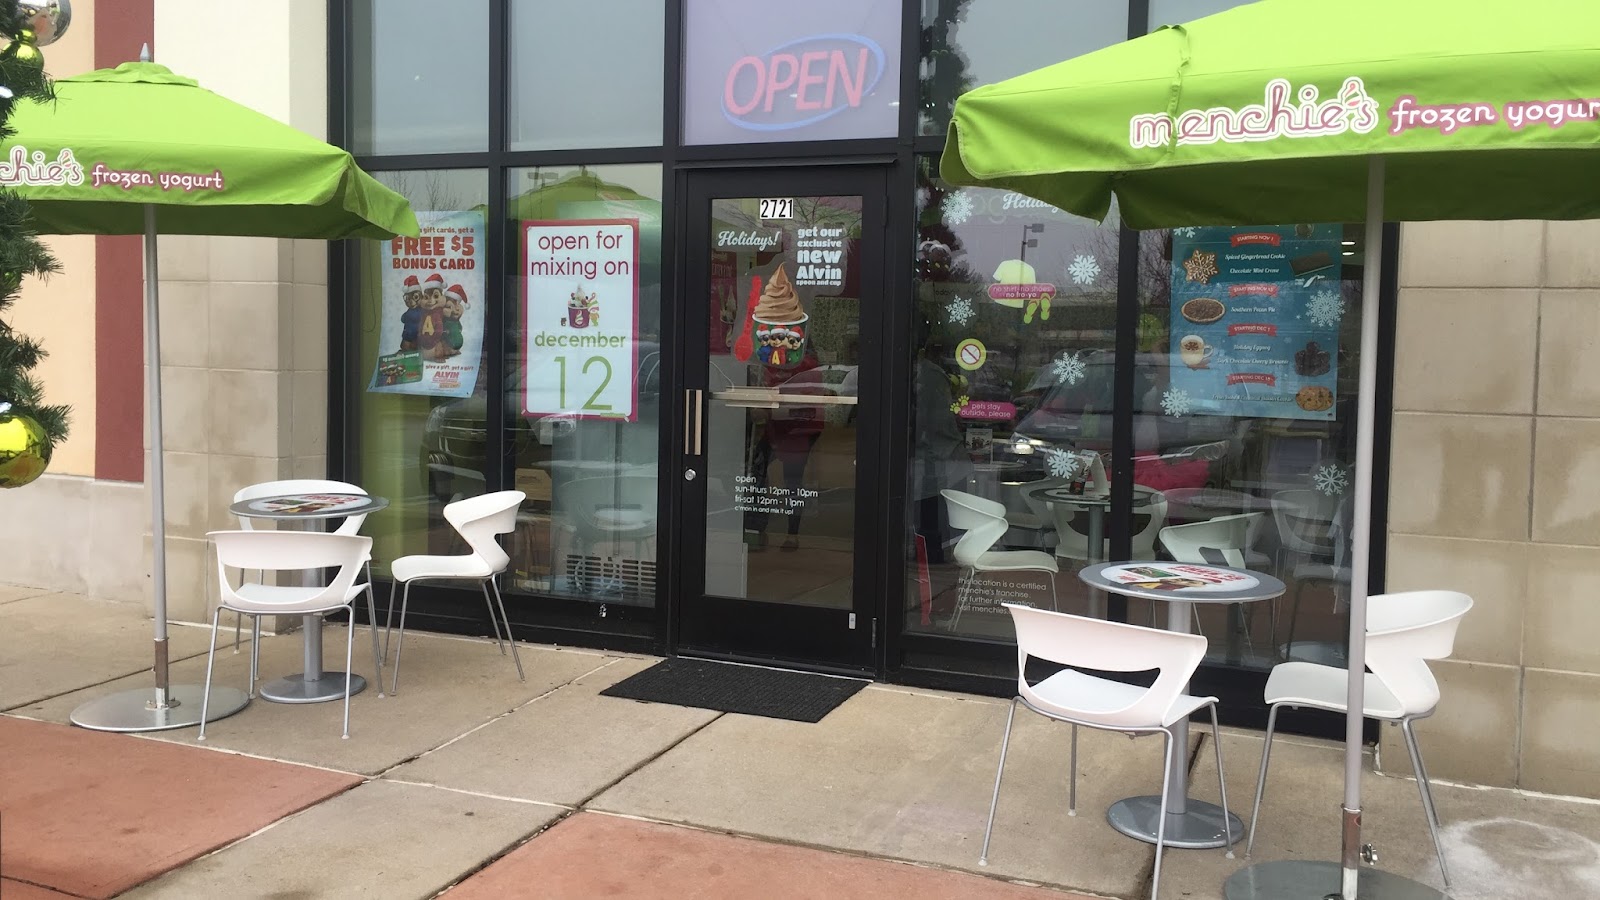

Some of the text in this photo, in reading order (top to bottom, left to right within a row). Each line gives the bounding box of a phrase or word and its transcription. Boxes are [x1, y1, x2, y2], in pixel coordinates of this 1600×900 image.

[724, 48, 868, 115] OPEN
[1130, 77, 1379, 148] menchie's
[1391, 98, 1496, 133] frozen
[92, 164, 154, 187] frozen
[159, 171, 223, 192] yogurt
[761, 199, 793, 218] 2721
[718, 230, 781, 251] Holidays!
[798, 226, 842, 238] get our
[391, 235, 475, 257] FREE $5
[538, 230, 624, 255] open for
[797, 239, 842, 247] exclusive
[392, 258, 475, 270] BONUS CARD
[797, 249, 842, 264] new
[531, 257, 630, 280] mixing on
[796, 264, 842, 280] Alvin
[534, 331, 627, 349] december
[553, 355, 613, 411] 12
[735, 475, 757, 484] open
[734, 485, 768, 495] sun-thurs
[768, 486, 791, 497] 12pm
[796, 488, 819, 498] 10pm
[757, 495, 779, 506] 12pm
[784, 497, 805, 508] 11pm
[972, 578, 1001, 587] location
[1015, 582, 1047, 591] certified
[969, 595, 993, 605] further
